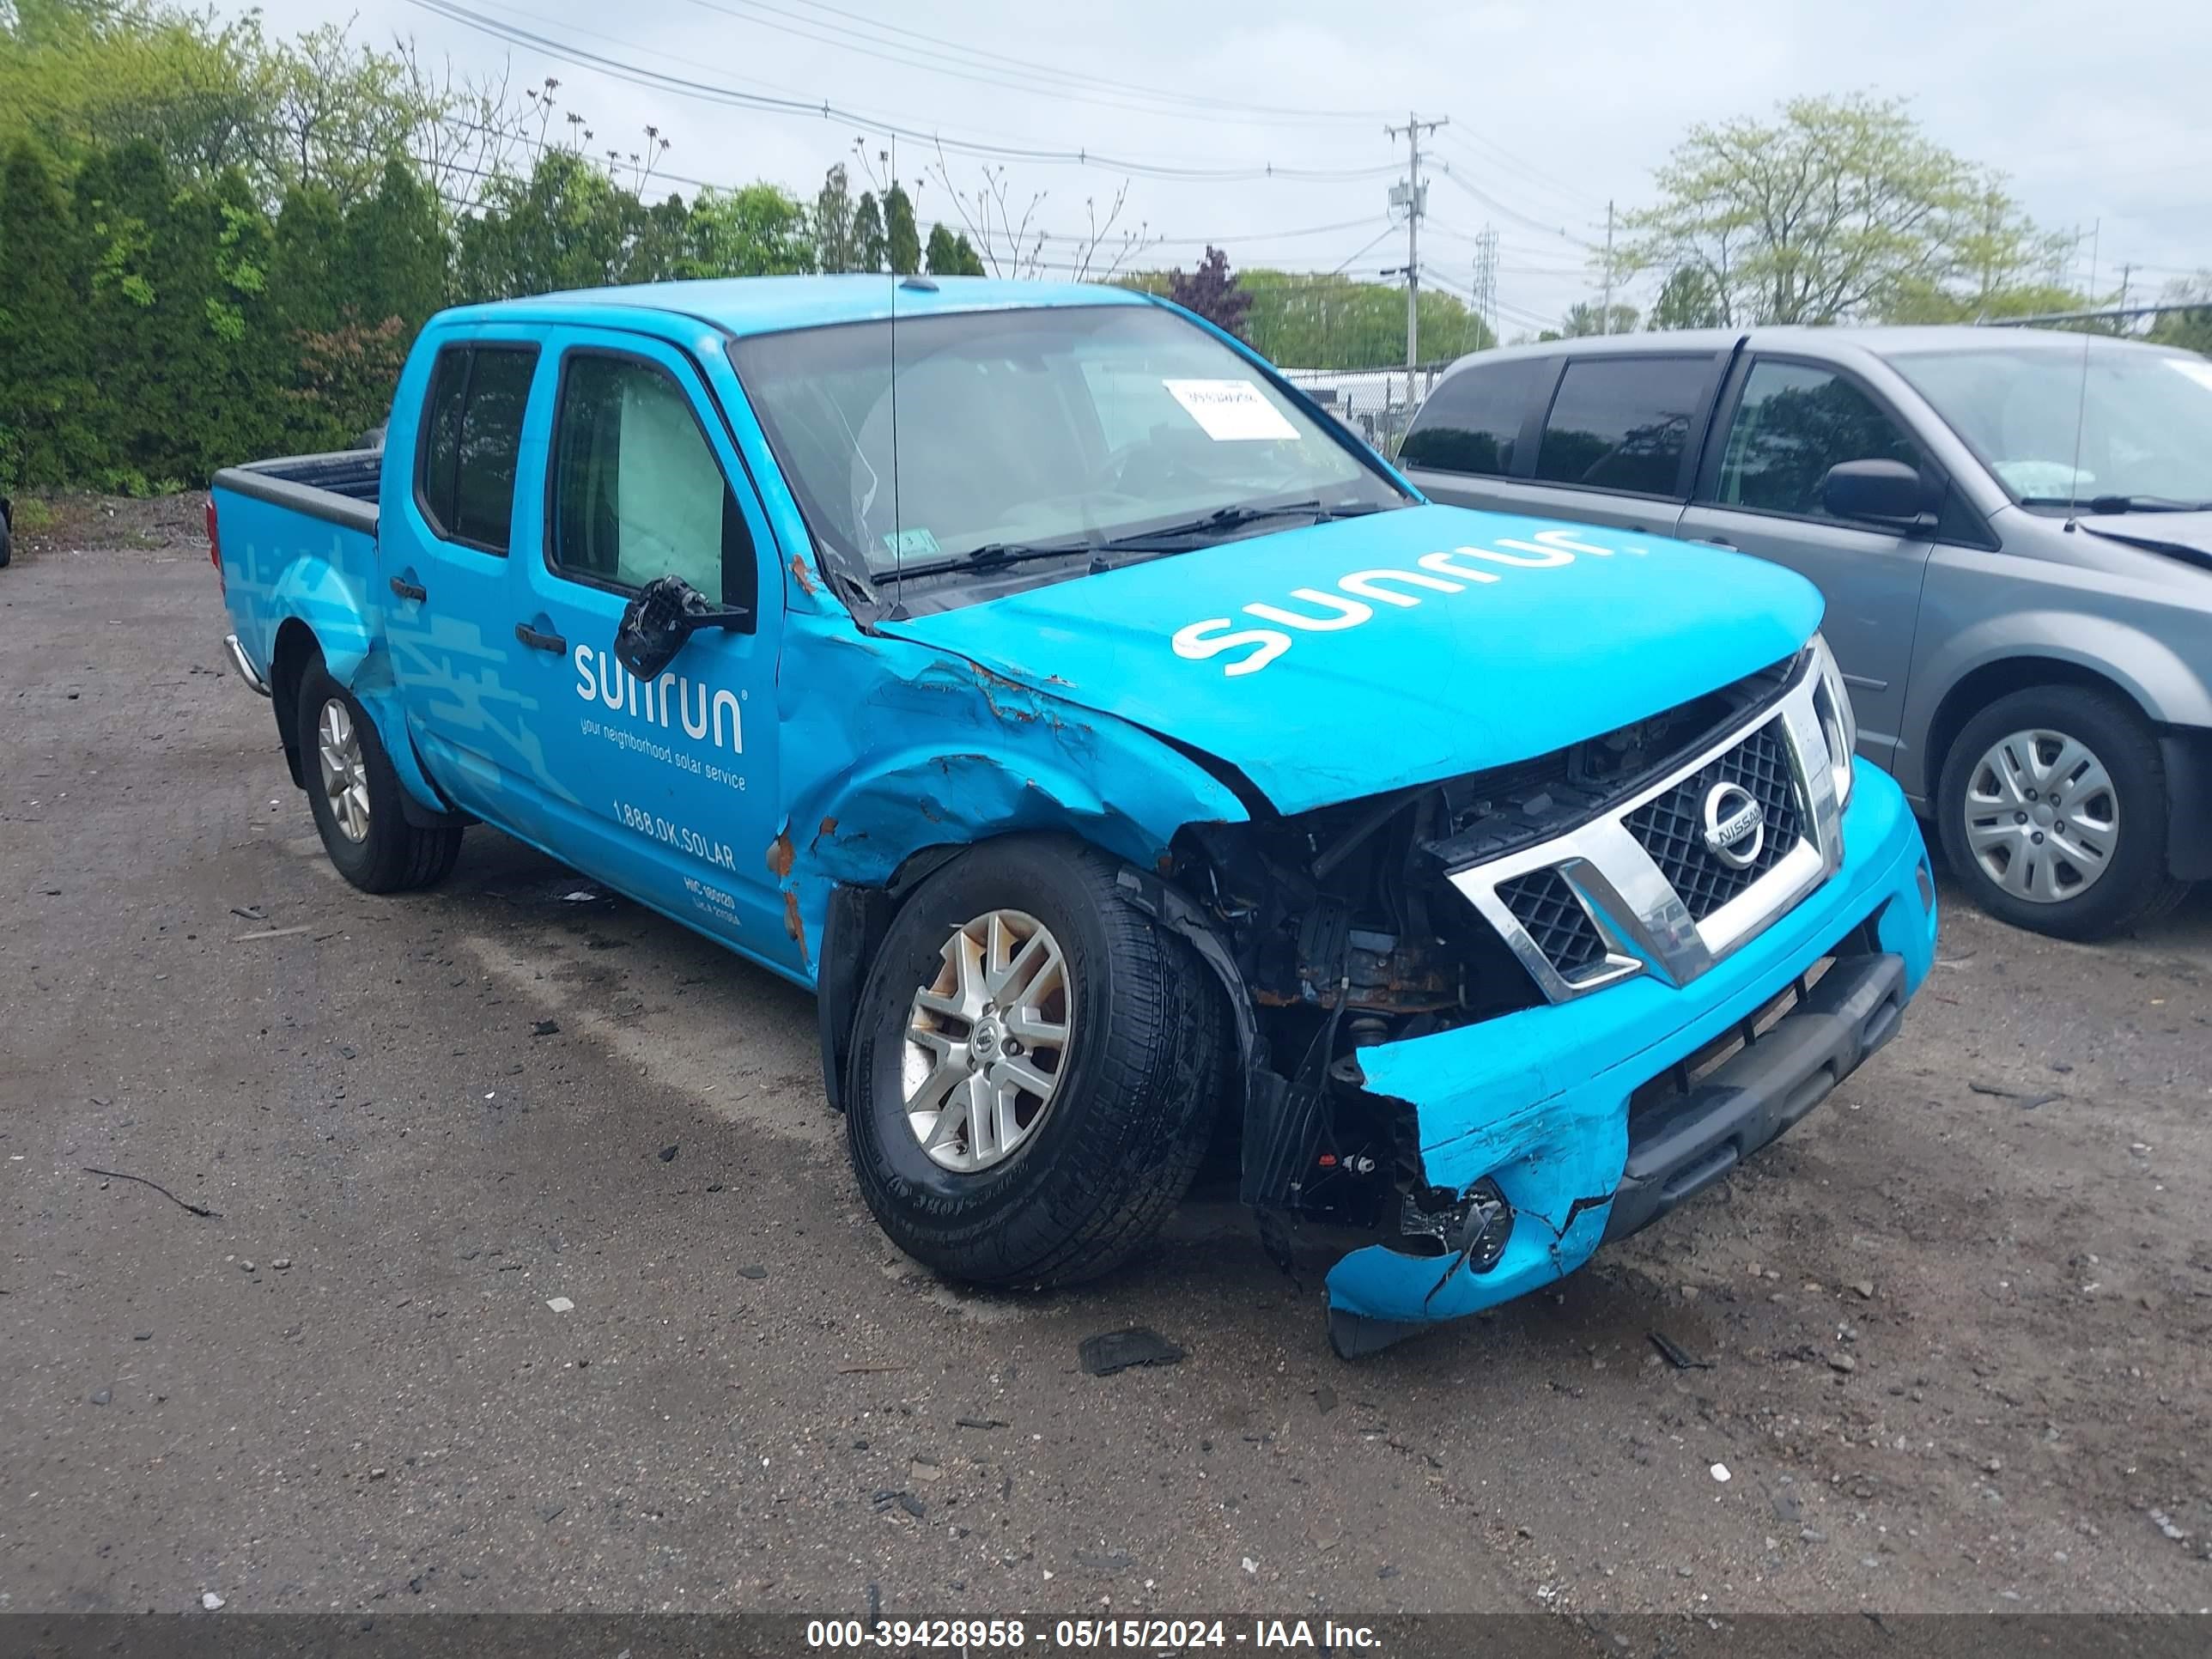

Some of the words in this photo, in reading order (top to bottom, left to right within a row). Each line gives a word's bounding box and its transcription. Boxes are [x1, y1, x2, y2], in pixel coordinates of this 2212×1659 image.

[1171, 530, 1615, 677] sunrun
[580, 716, 601, 736] your
[604, 725, 673, 763] neighborhood
[675, 752, 702, 775] solar
[705, 763, 746, 792] service
[613, 799, 737, 872] 1.888.OK.SOLAR
[1718, 805, 1762, 844] NISSAN
